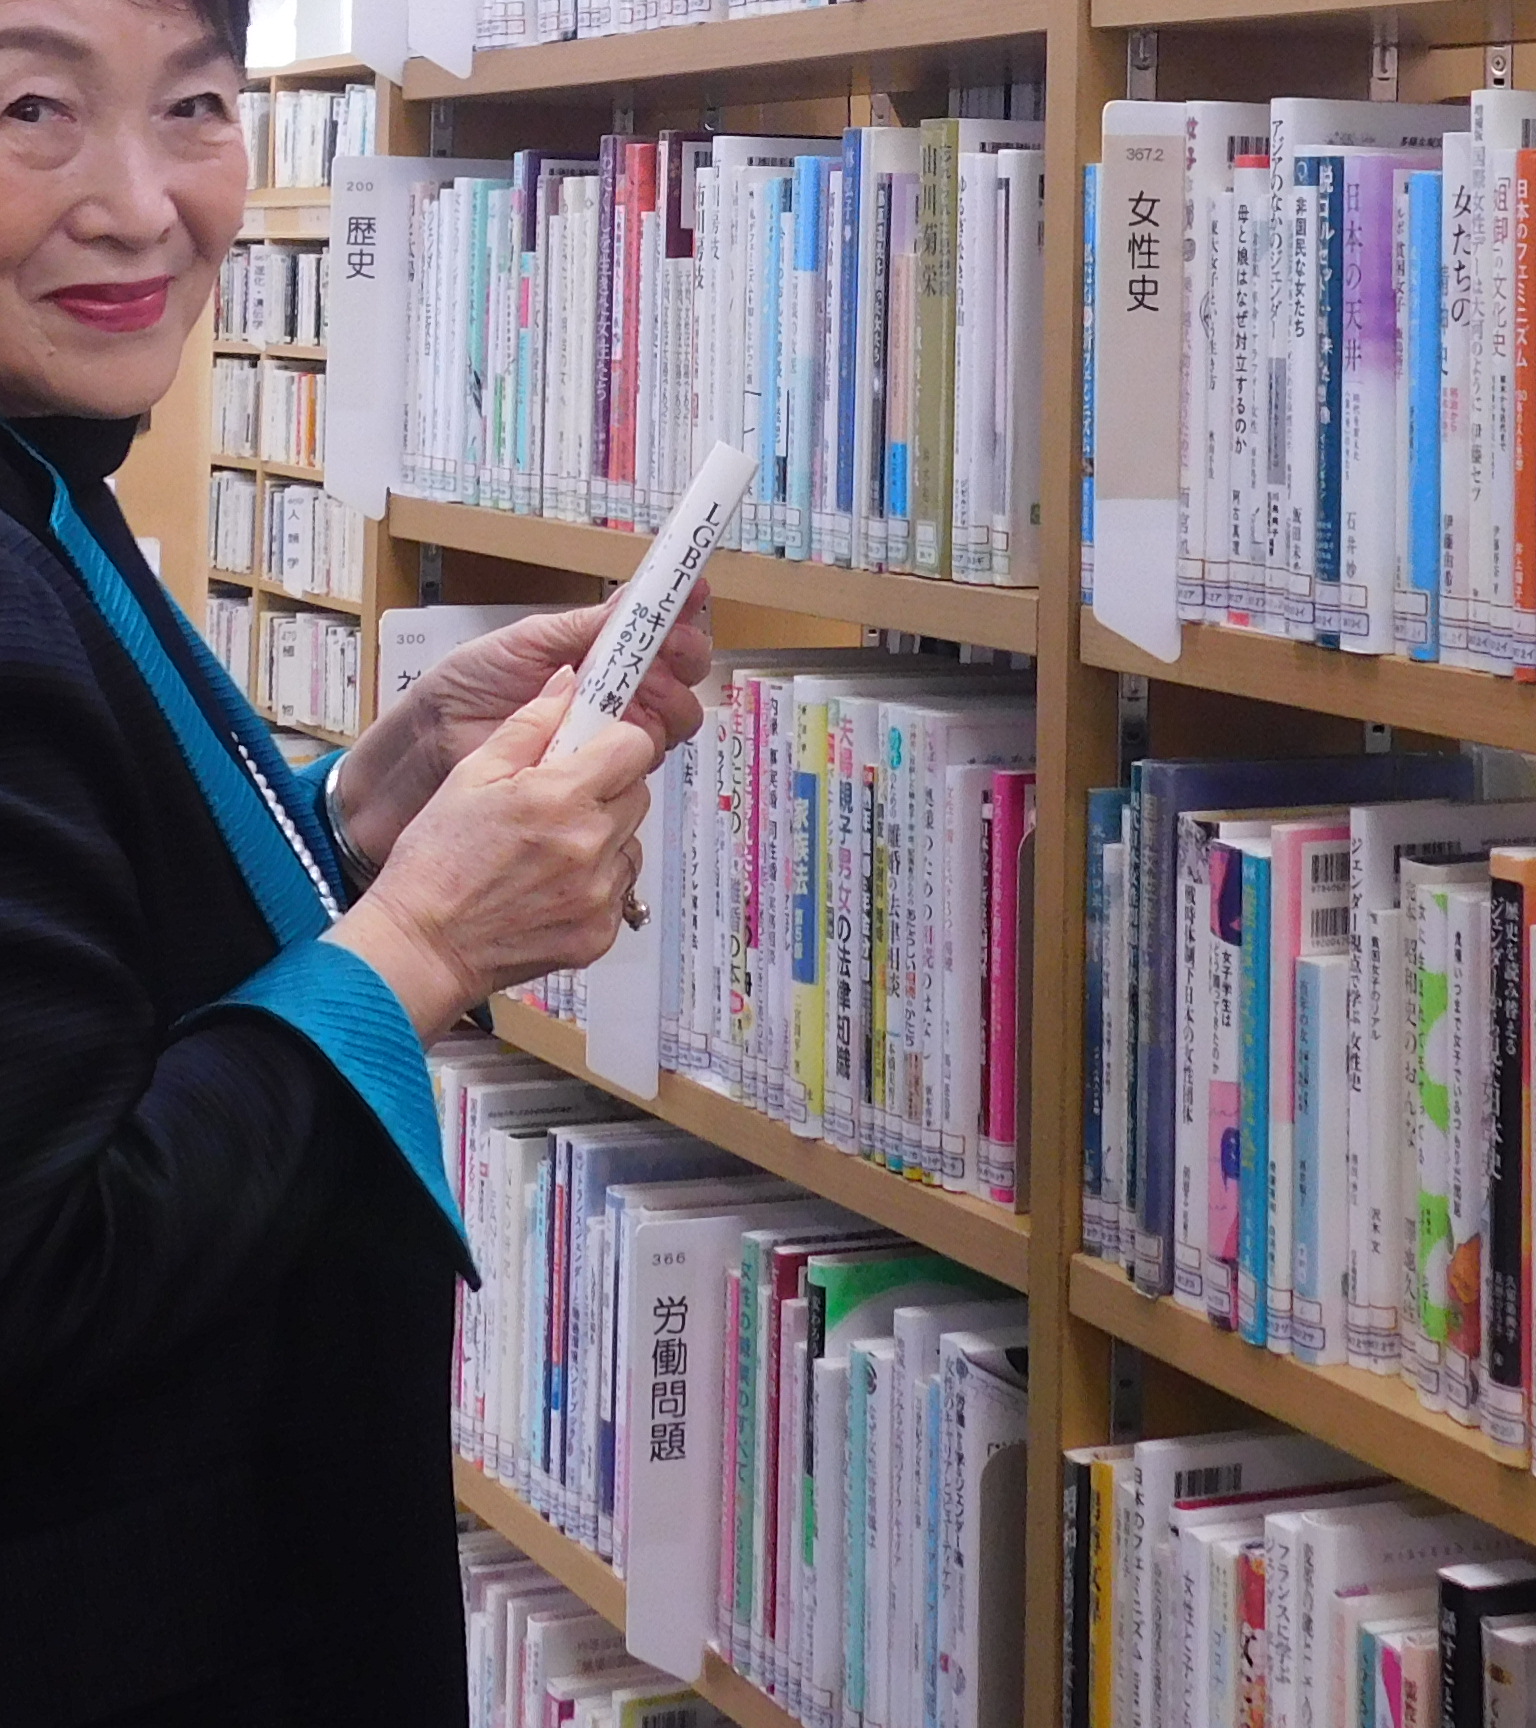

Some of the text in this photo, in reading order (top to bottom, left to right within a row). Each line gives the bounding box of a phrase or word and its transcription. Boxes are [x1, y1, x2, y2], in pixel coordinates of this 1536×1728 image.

[345, 181, 374, 193] 200
[920, 141, 939, 298] 山川菊栄
[1125, 147, 1164, 162] 367.2
[345, 216, 377, 279] 歴史
[694, 183, 706, 291] 市川房枝
[1127, 191, 1161, 313] 女性史
[1269, 119, 1285, 341] アジアのなかのジェンダー
[1293, 194, 1308, 341] 非国民な女たち
[1342, 180, 1365, 374] 日本の天井
[1451, 184, 1473, 328] 女たちの
[1469, 143, 1486, 416] 国際女性デーは大河のように
[1514, 179, 1529, 369] 日本のフェミニズム
[1234, 202, 1251, 456] 母と娘はなぜ対立するのか
[397, 633, 426, 645] 300
[588, 601, 650, 705] 20人のストーリー
[598, 501, 721, 719] LGBTとキリスト教
[792, 792, 810, 897] 家族法
[1180, 883, 1197, 1127] 戦時体制下日本の女性団体
[1220, 948, 1233, 1028] 女子学生は
[1402, 936, 1419, 1151] 昭和史のおんな
[1504, 900, 1517, 1058] 歴史を読み替える
[1348, 1036, 1363, 1095] 女性史
[652, 1252, 686, 1266] 366
[649, 1295, 688, 1462] 労働問題
